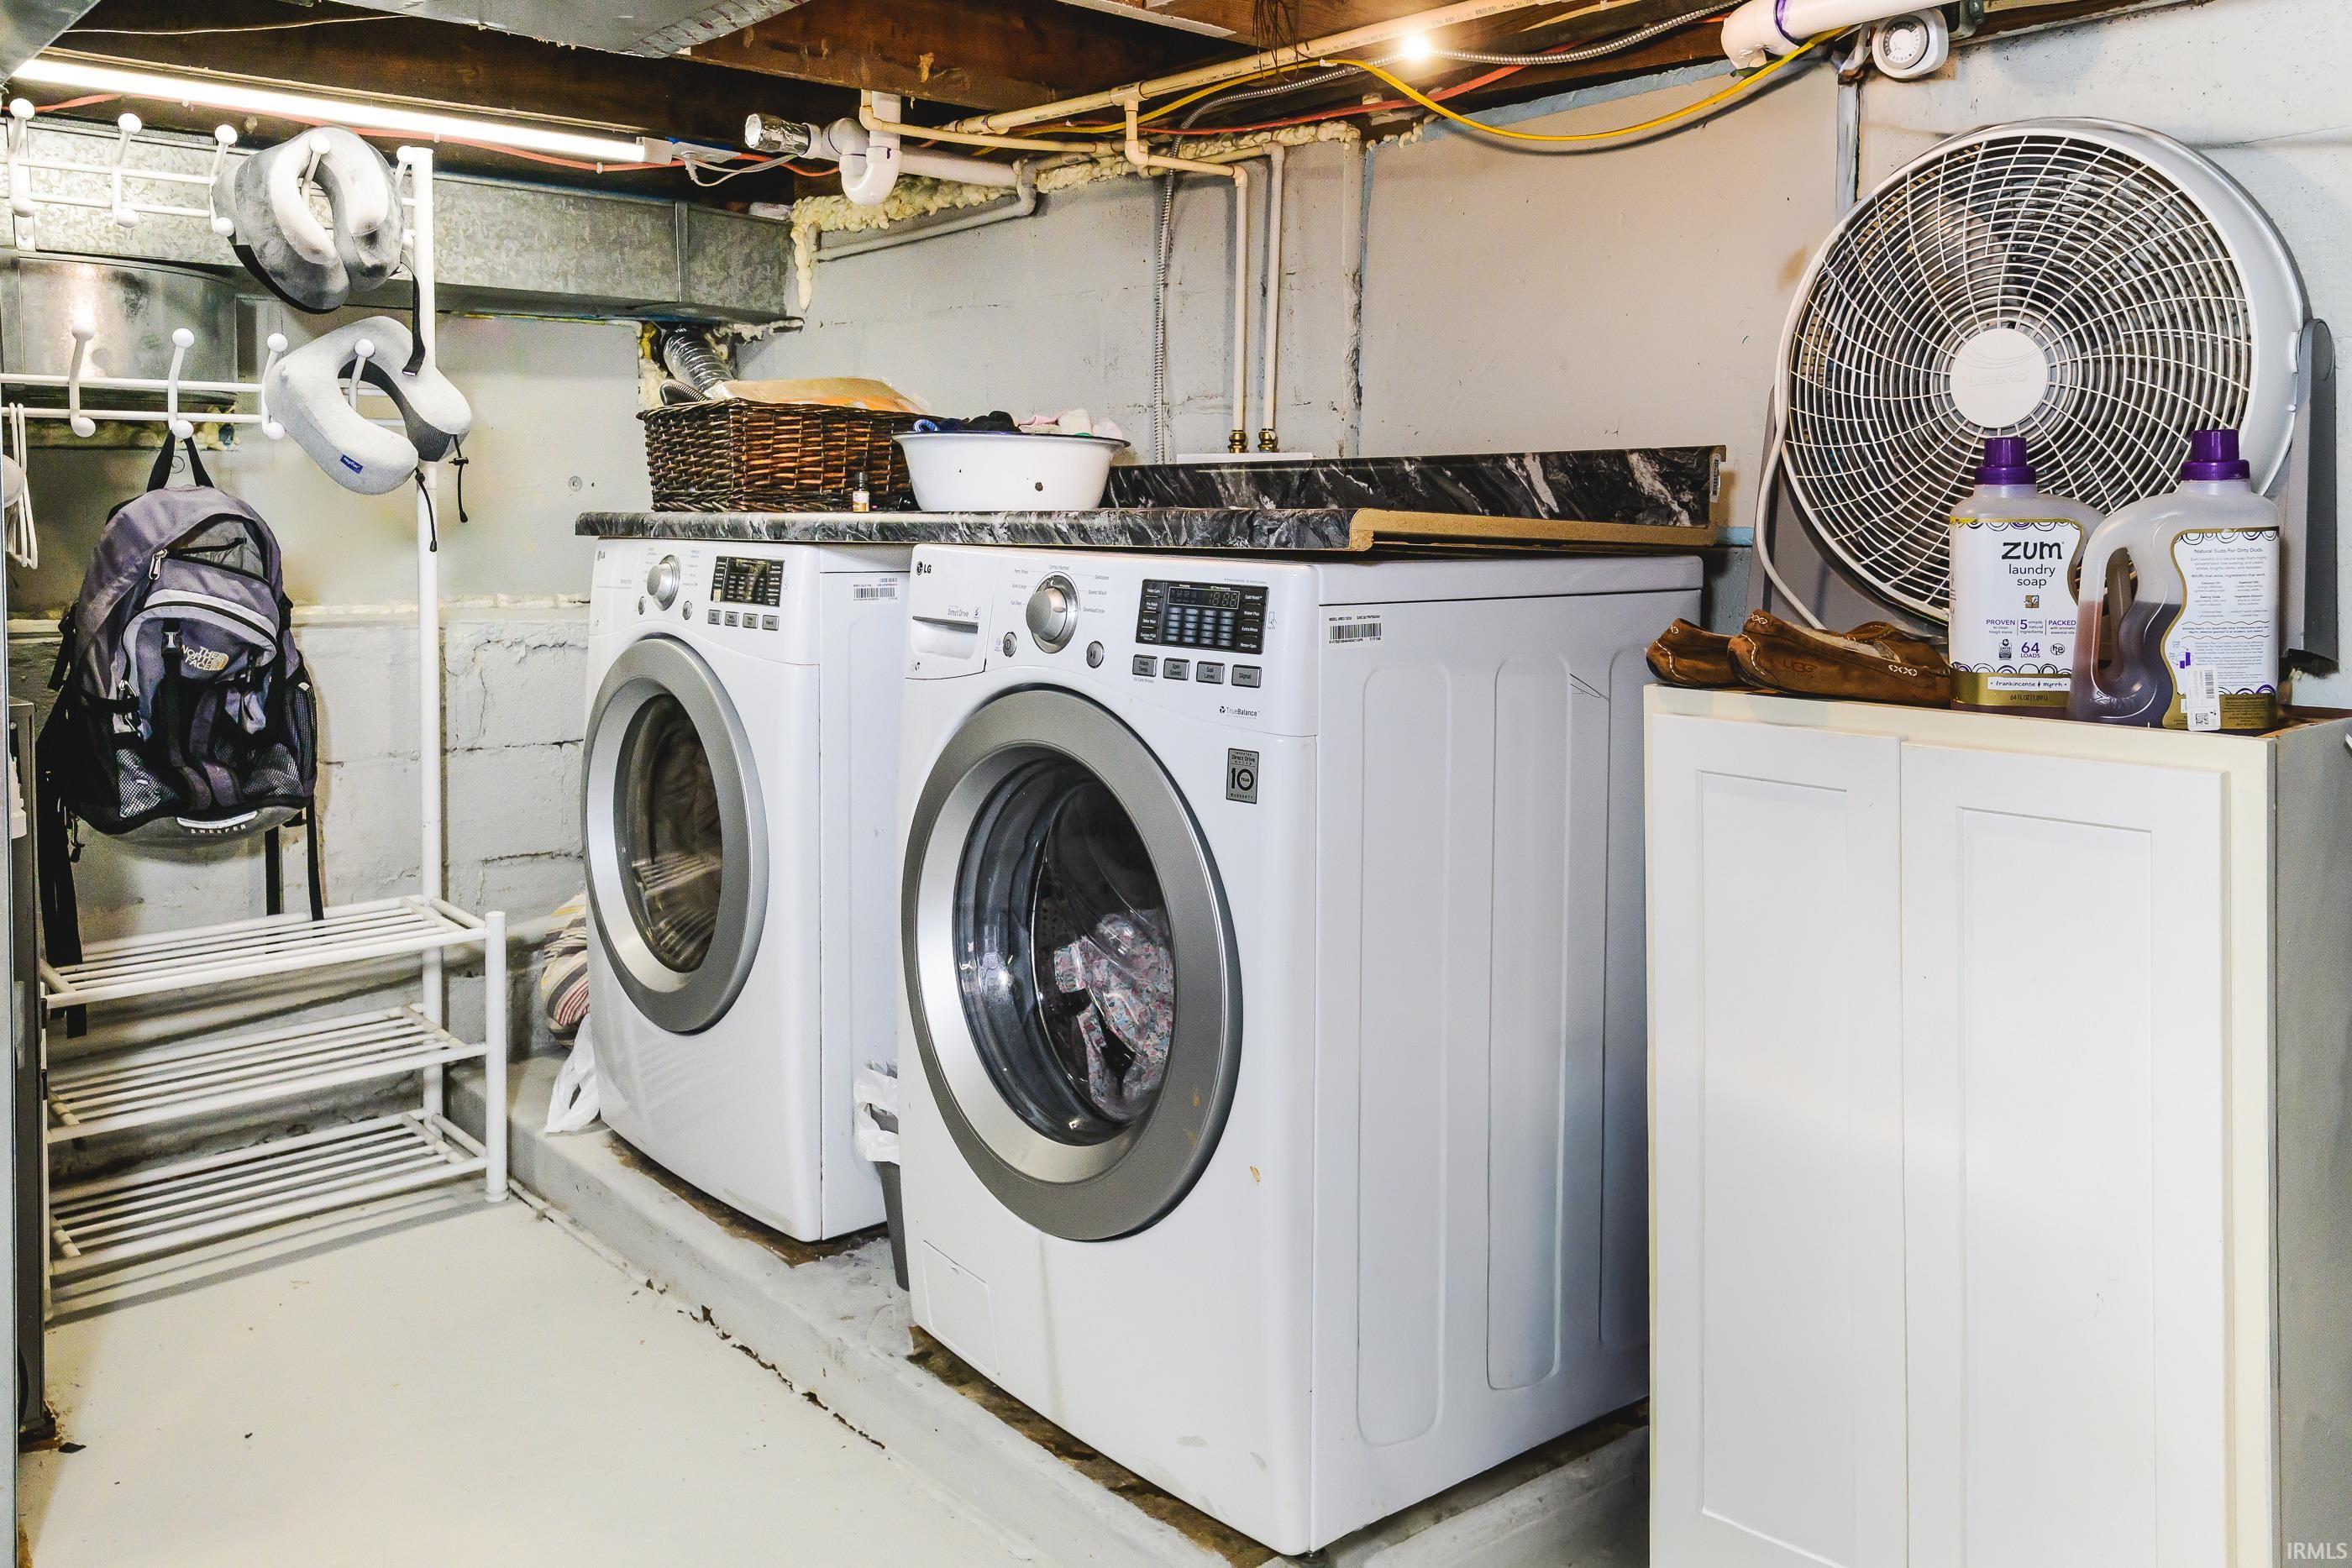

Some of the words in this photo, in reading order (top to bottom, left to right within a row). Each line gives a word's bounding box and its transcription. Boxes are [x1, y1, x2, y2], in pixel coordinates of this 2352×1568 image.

[2008, 564, 2056, 578] laundry
[2017, 579, 2047, 589] soap
[2020, 619, 2028, 630] 5
[181, 644, 213, 662] NORTH
[200, 646, 219, 658] THE
[2021, 642, 2040, 653] 64
[185, 656, 212, 670] FACE
[1226, 706, 1257, 717] TrueBalance
[1231, 767, 1254, 791] 10
